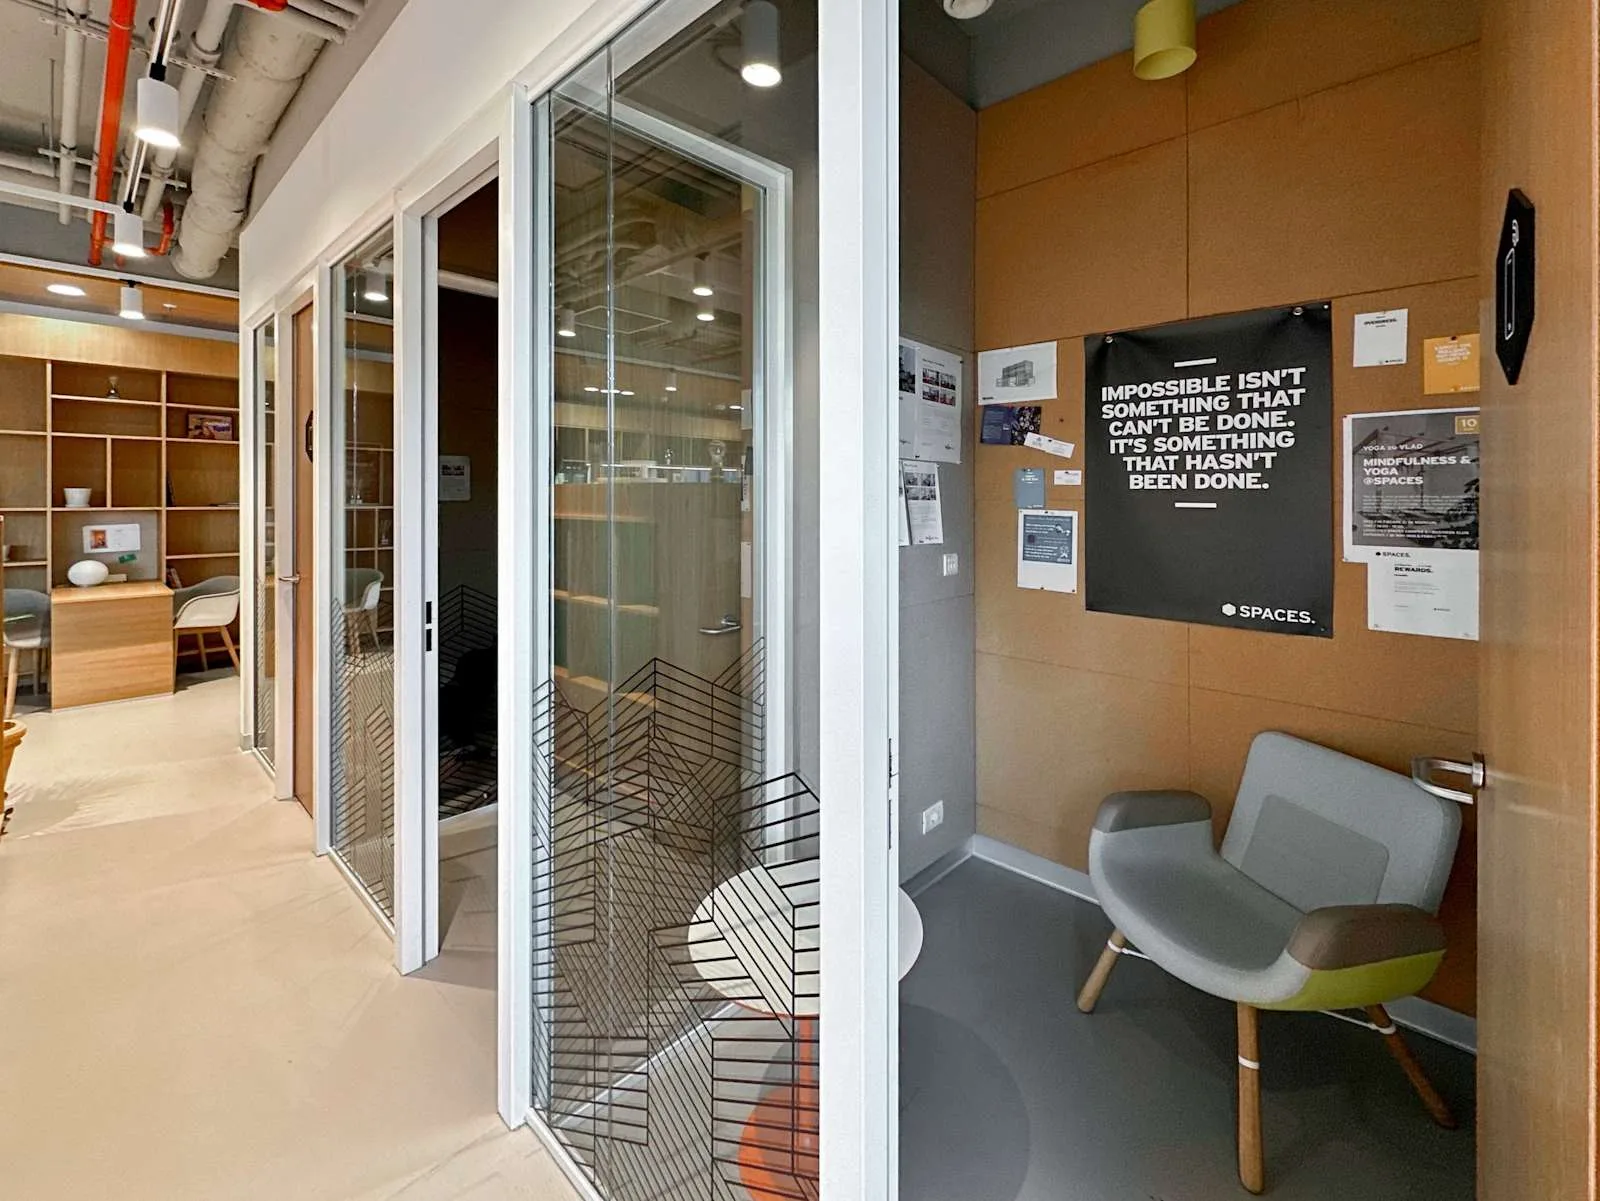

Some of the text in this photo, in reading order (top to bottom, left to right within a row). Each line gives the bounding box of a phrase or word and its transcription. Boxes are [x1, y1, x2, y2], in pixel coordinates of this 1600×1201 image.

[1101, 367, 1306, 402] IMPOSSIBLE ISN'T
[1101, 388, 1306, 419] SOMETHING THAT
[1108, 410, 1295, 437] CAN'T BE DONE.
[1461, 418, 1477, 428] 10
[1109, 430, 1296, 454] IT'S SOMETHING
[1122, 451, 1278, 471] THAT HASN'T
[1363, 456, 1472, 467] MINDFULNESS &
[1129, 472, 1270, 490] BEEN DONE.
[1363, 468, 1399, 476] YOGA
[1363, 476, 1424, 485] @SPACES
[1239, 605, 1316, 624] SPACES.
